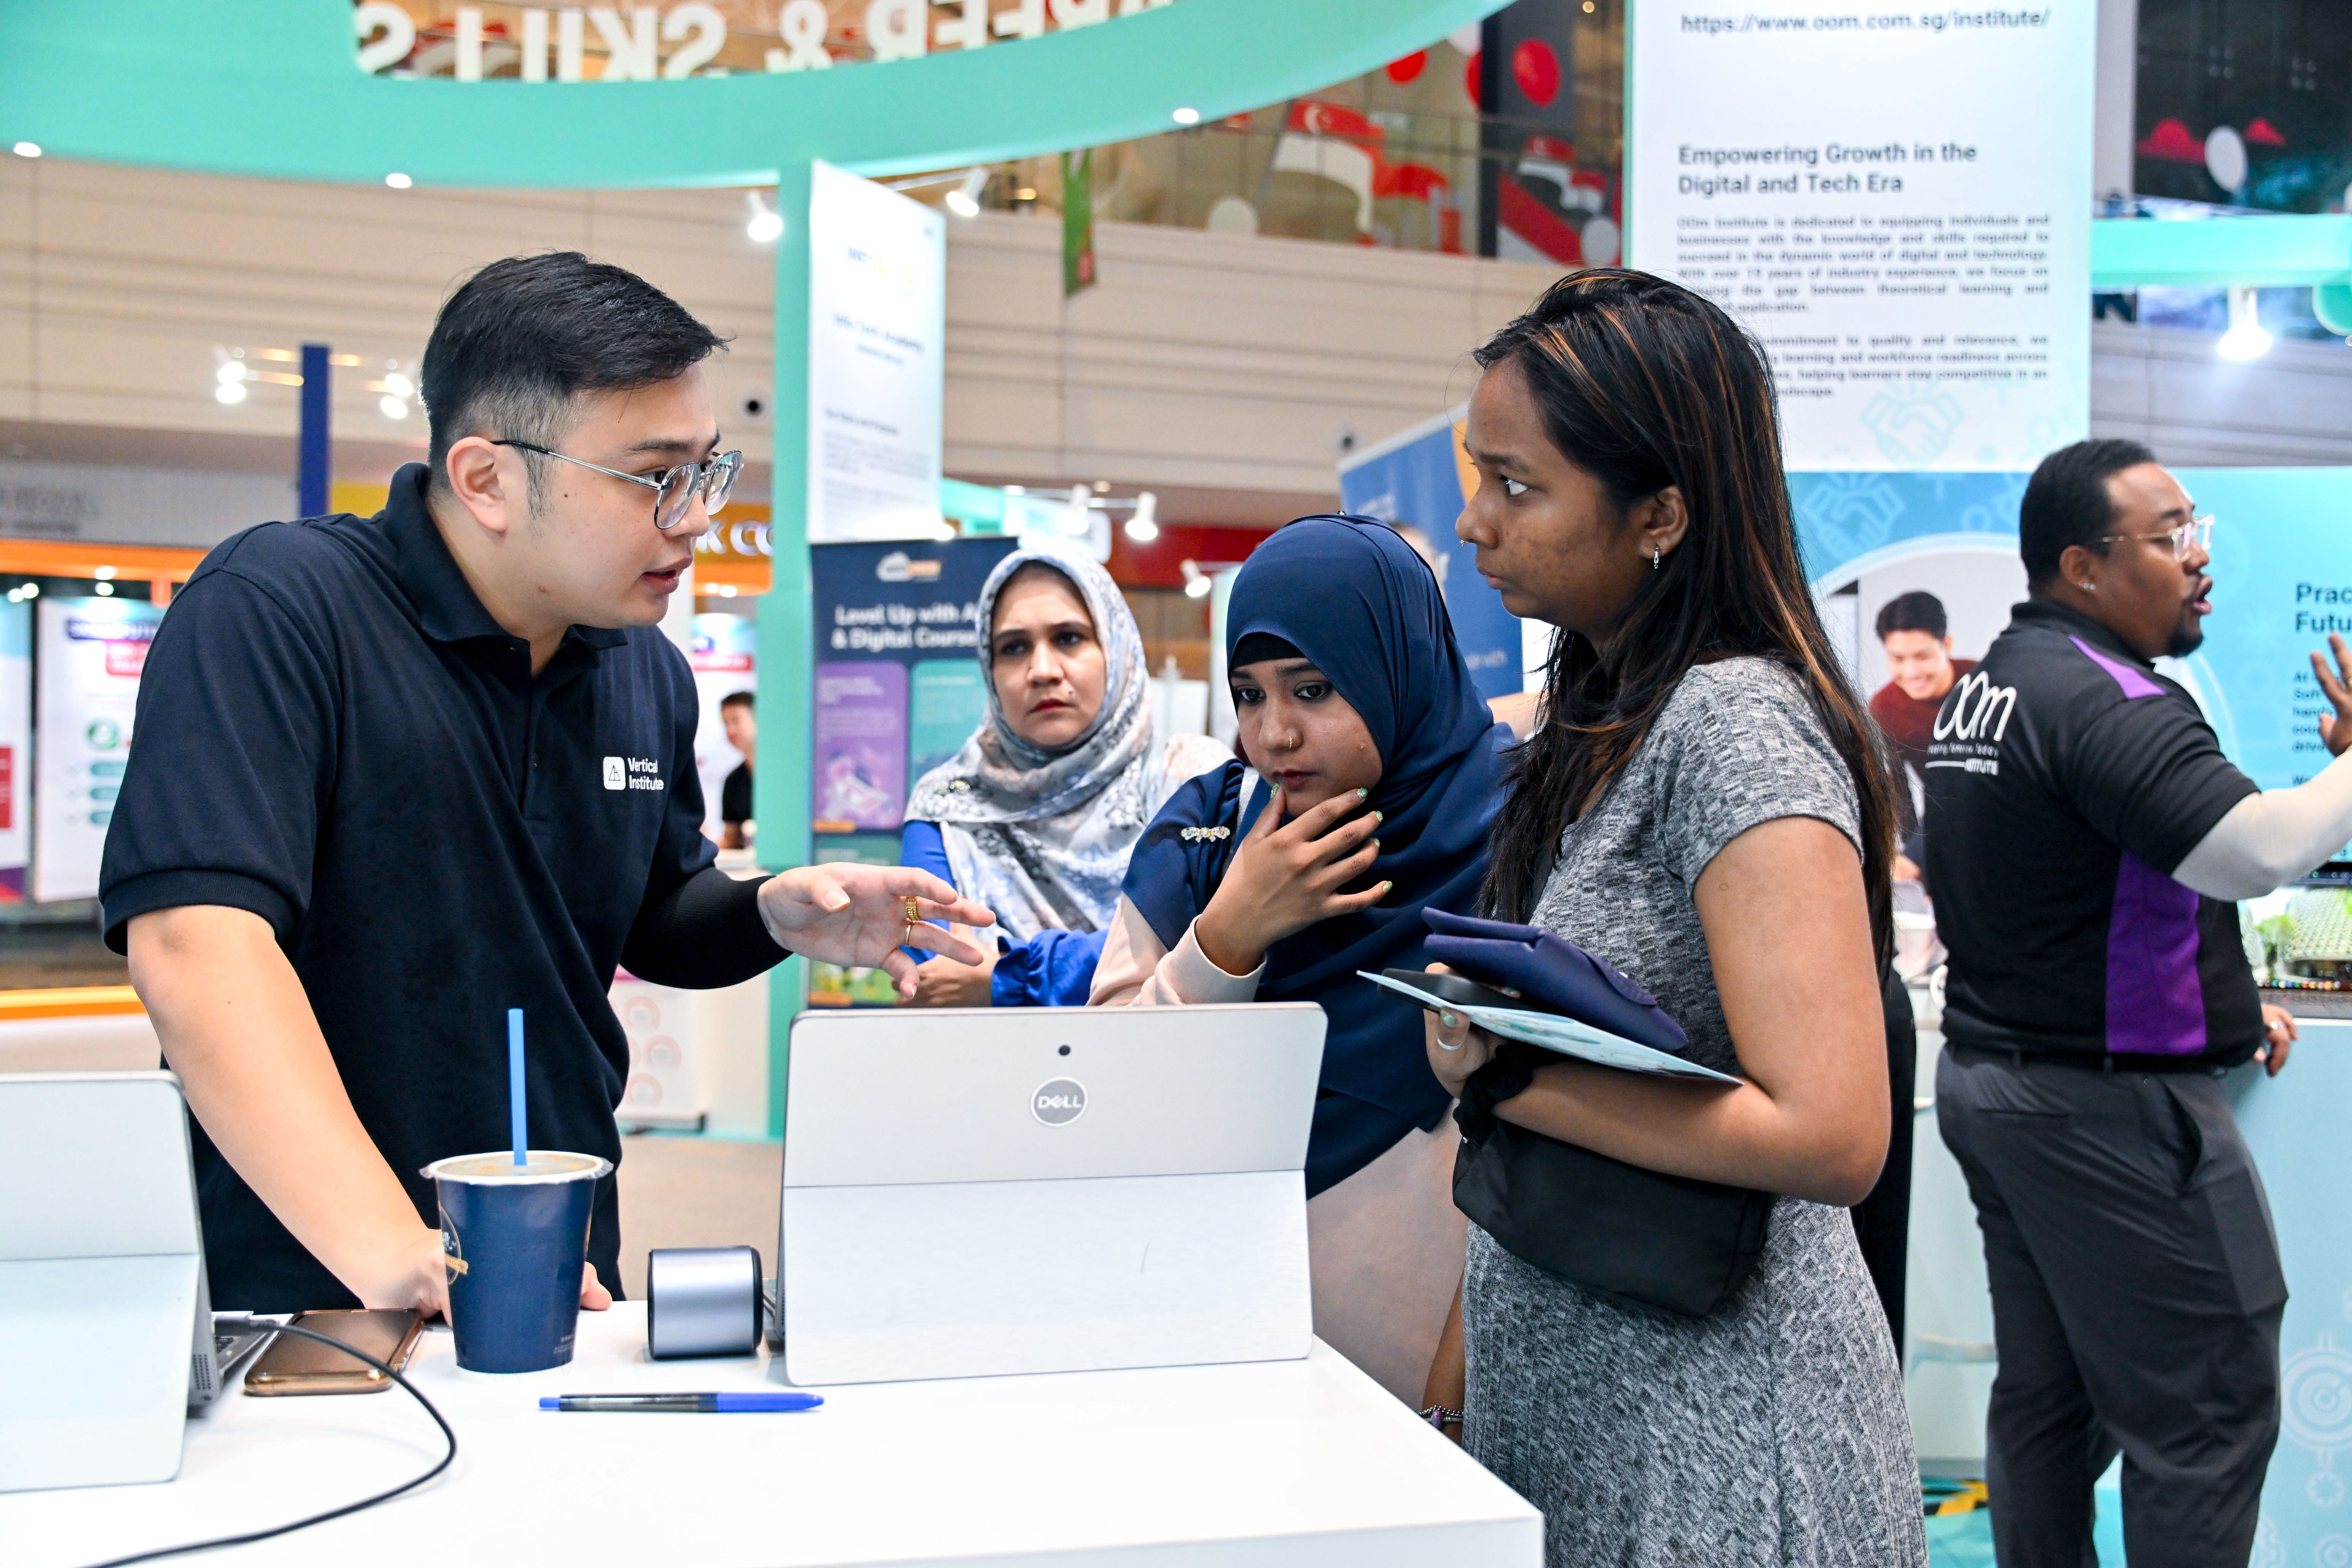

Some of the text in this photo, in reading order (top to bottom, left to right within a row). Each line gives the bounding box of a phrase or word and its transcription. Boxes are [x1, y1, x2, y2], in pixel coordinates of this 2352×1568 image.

[1679, 143, 1976, 167] Empowering Growth in the
[1678, 173, 1903, 196] Digital and Tech Era
[1791, 215, 1855, 228] dedicated
[2025, 213, 2050, 226] and
[1820, 232, 1892, 246] knowledge
[1899, 232, 1925, 244] and
[1944, 248, 1969, 261] and
[2024, 283, 2049, 294] and
[1764, 335, 1839, 347] ommitment
[1920, 334, 1946, 346] and
[1839, 351, 1864, 364] and
[835, 602, 976, 628] Level Up with A
[849, 628, 913, 653] Digital
[627, 757, 658, 773] Vertical
[629, 775, 664, 790] Institute
[1037, 1094, 1082, 1110] DELL
